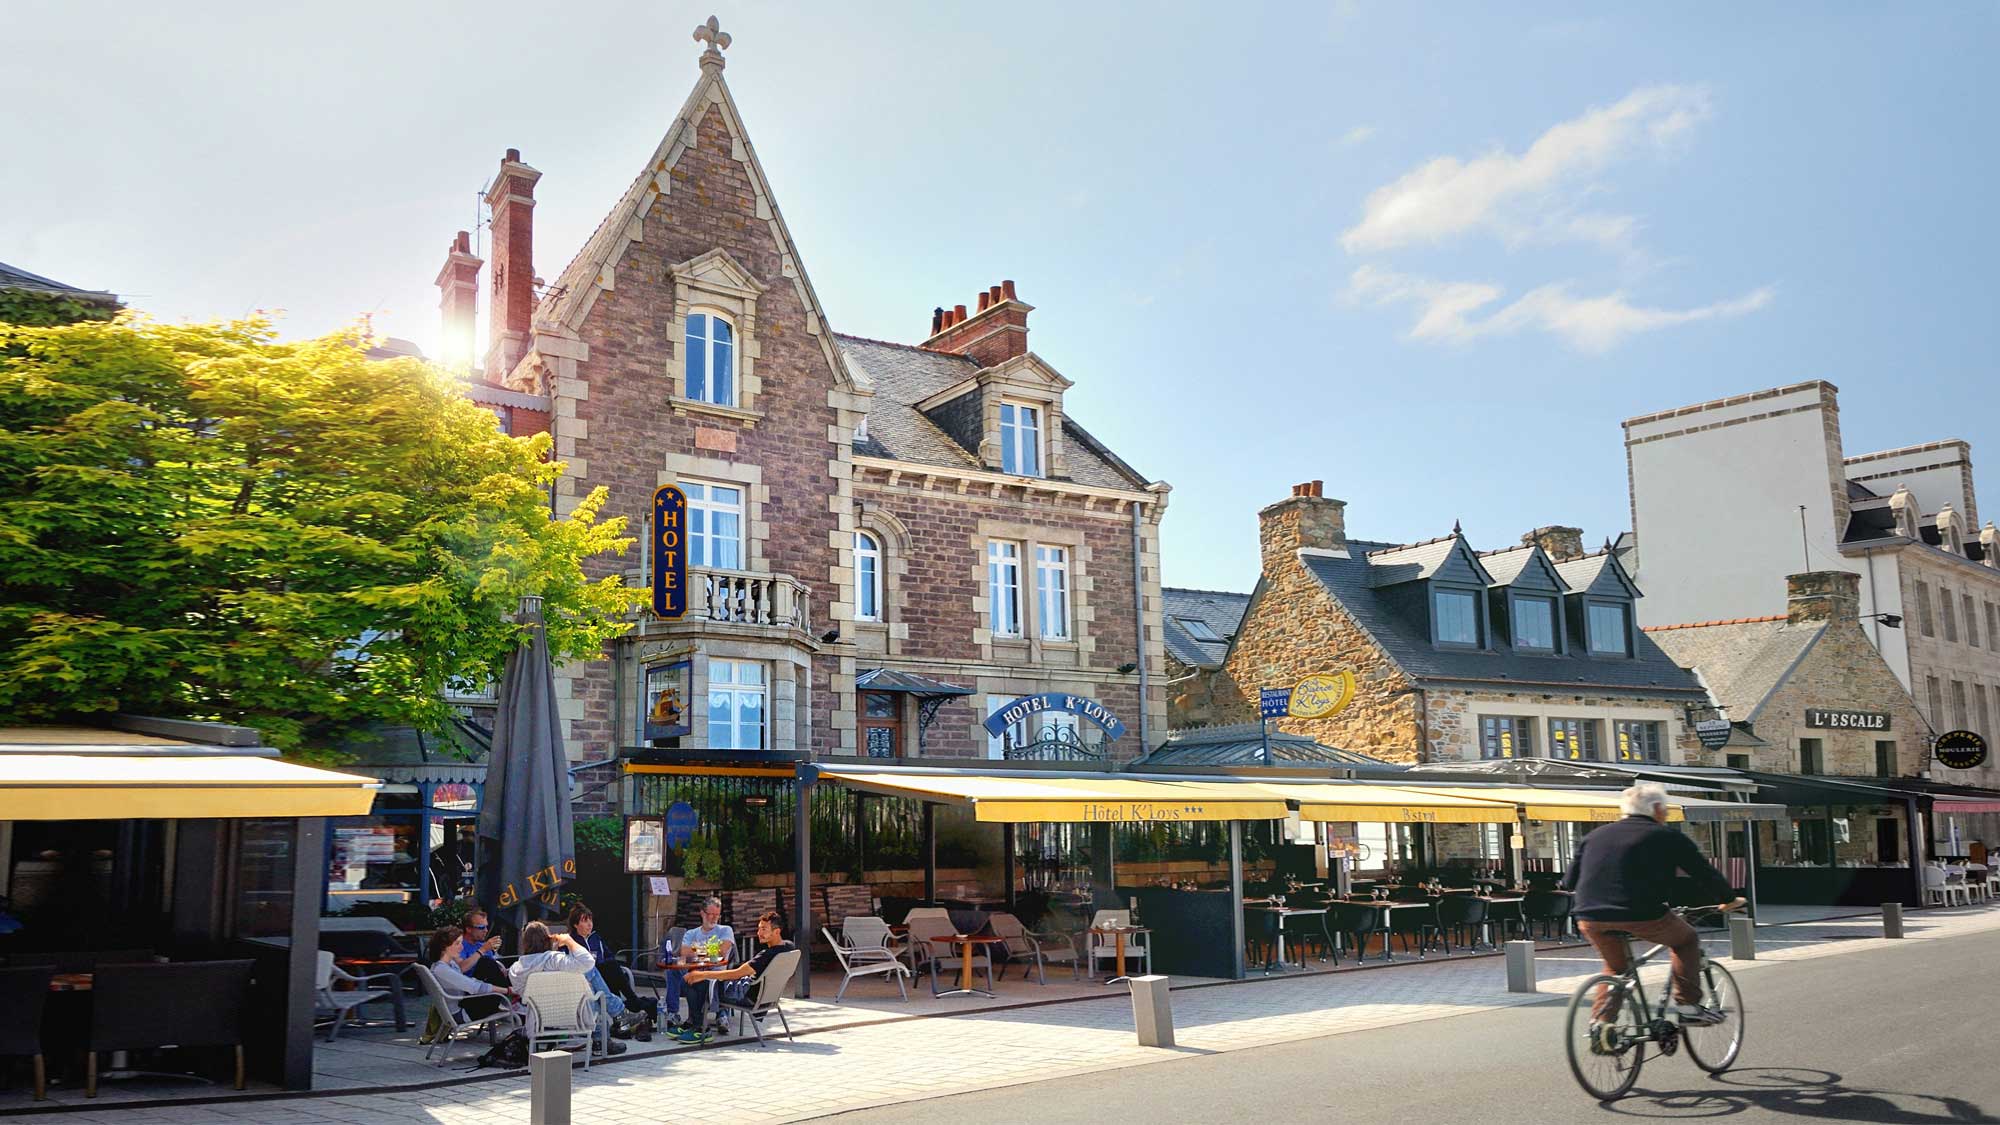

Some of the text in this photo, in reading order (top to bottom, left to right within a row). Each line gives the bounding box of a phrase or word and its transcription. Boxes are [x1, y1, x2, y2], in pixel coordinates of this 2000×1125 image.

[662, 510, 679, 610] HOTEL
[1003, 696, 1051, 726] HOTEL
[1262, 698, 1288, 708] HÔTEL
[1814, 712, 1884, 728] L'ESCALE
[1083, 803, 1124, 820] Hôtel
